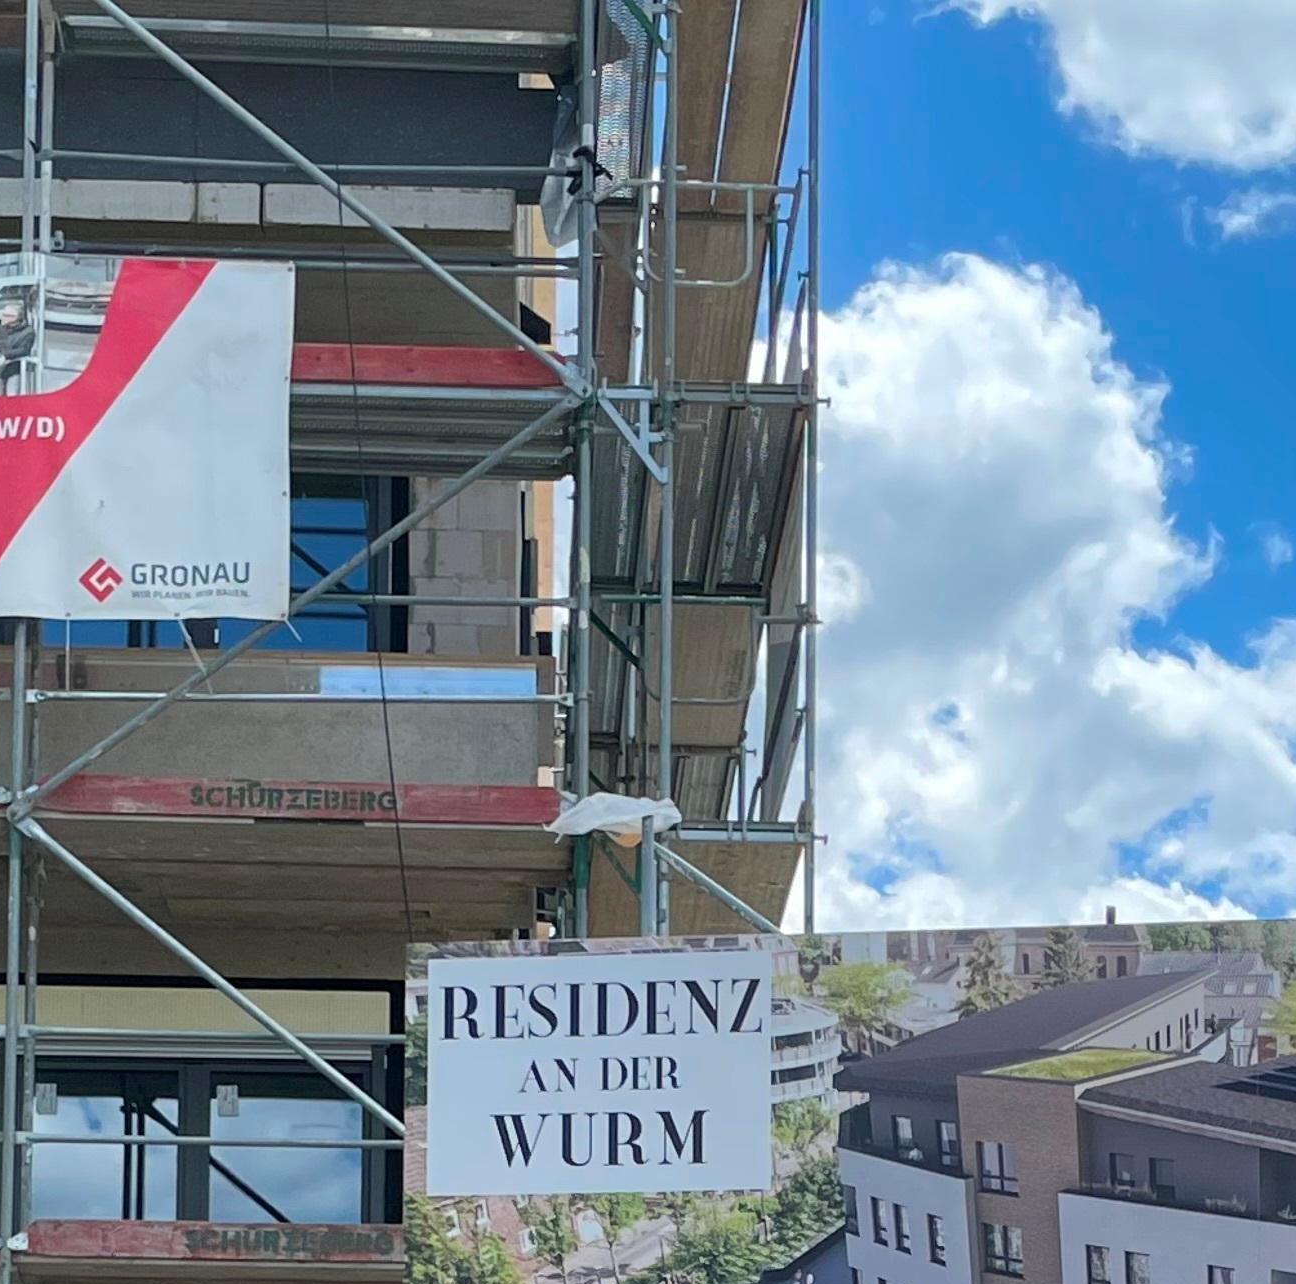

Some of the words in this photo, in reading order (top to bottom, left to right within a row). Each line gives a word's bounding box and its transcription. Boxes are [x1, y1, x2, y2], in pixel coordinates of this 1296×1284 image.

[131, 562, 251, 587] GRONAU
[438, 977, 763, 1041] RESIDENZ
[518, 1057, 579, 1093] AN
[599, 1056, 682, 1091] DER
[489, 1109, 710, 1168] WURM
